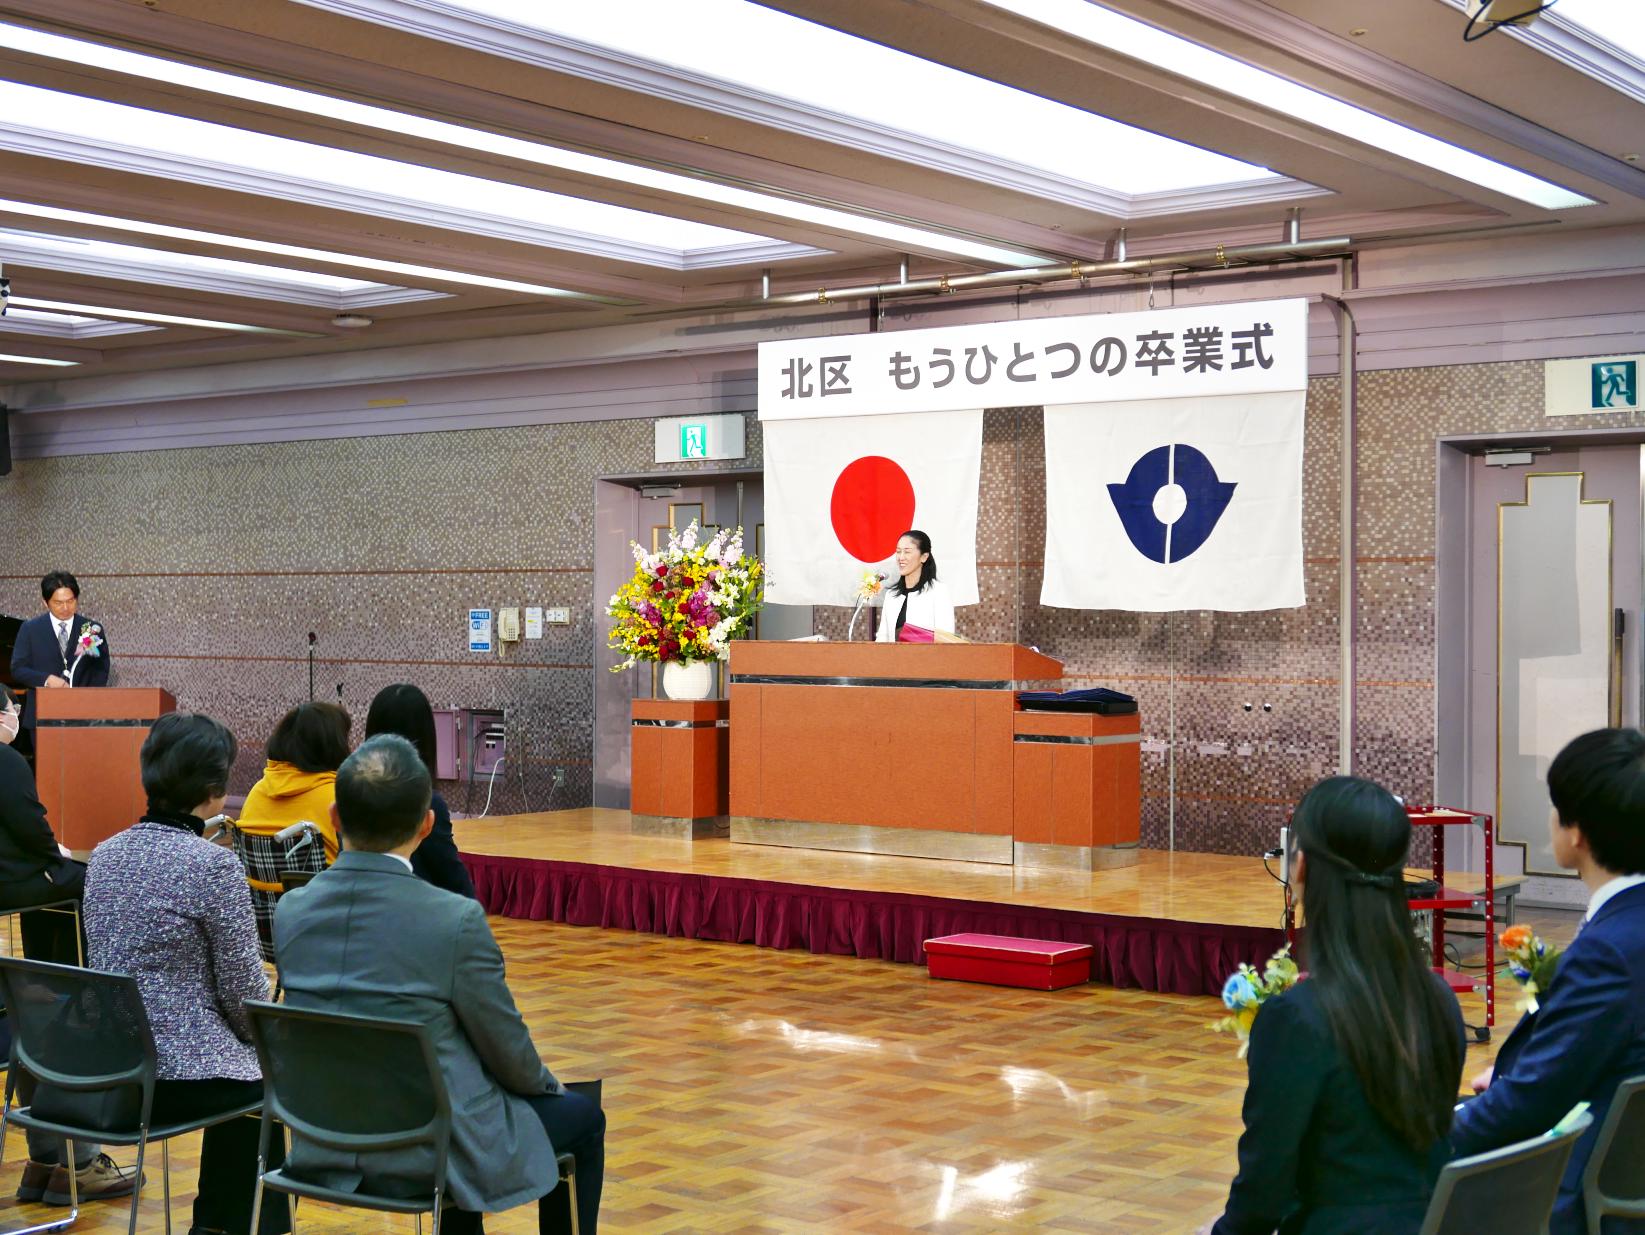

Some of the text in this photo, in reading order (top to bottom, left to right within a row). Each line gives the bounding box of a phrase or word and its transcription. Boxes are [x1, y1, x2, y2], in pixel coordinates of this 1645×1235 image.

[781, 323, 1274, 400] 北区 もうひとつの卒業式
